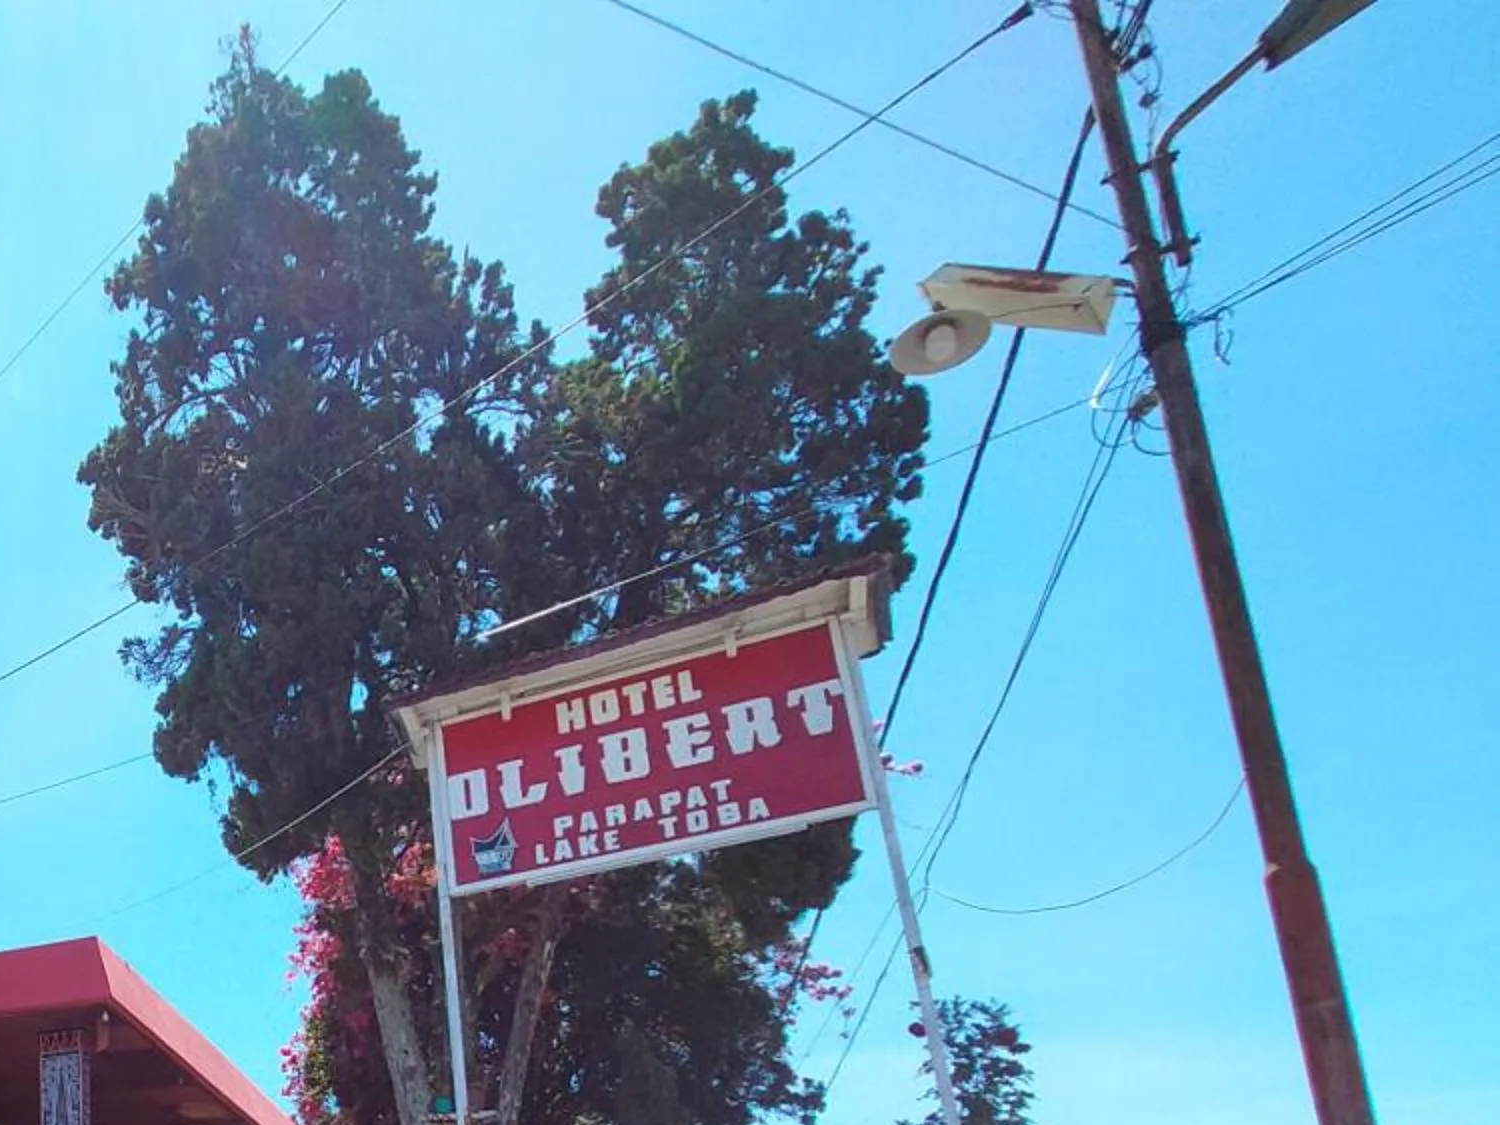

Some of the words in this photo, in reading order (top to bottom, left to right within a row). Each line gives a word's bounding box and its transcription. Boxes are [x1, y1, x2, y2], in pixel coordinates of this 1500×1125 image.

[555, 670, 703, 735] HOTEL
[535, 829, 622, 865] LAKE
[657, 797, 771, 839] TOBA
[553, 778, 733, 838] PARAPAT
